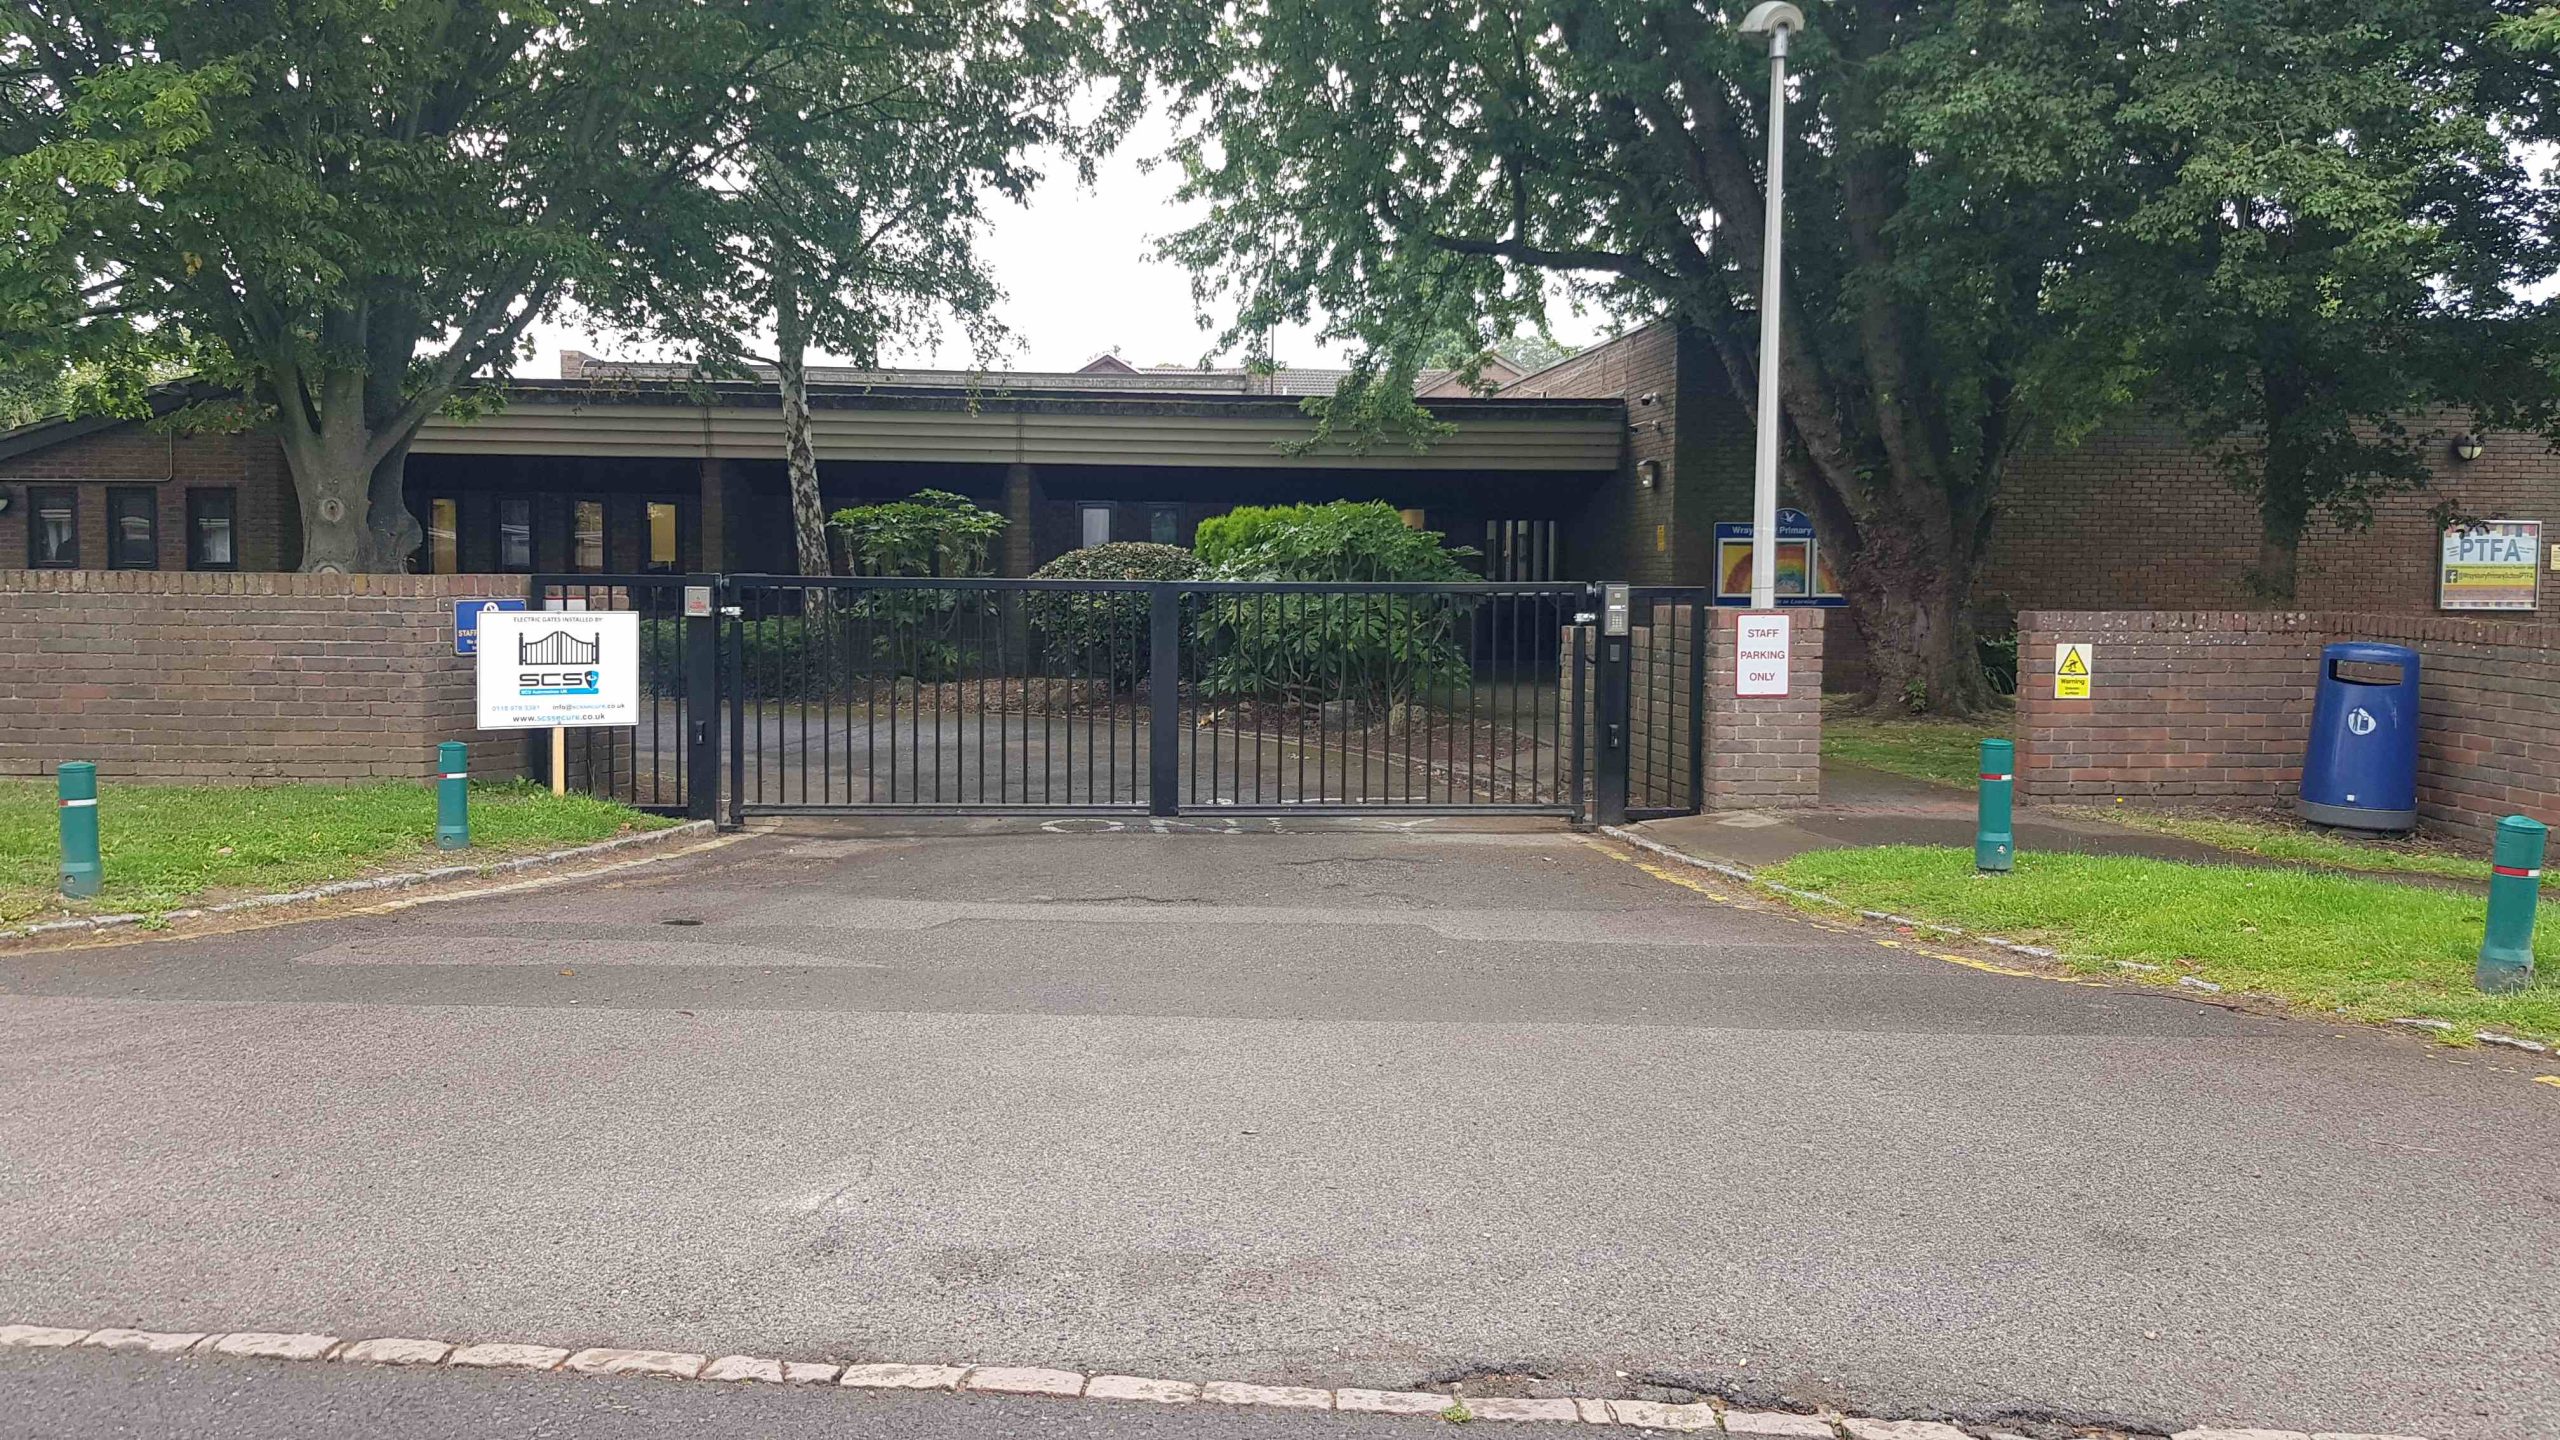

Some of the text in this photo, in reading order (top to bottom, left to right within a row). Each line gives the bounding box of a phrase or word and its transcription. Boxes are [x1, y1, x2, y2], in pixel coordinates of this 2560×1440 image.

[1779, 526, 1812, 536] Primary
[2458, 538, 2522, 562] PTFA
[1747, 628, 1780, 638] STAFF
[1740, 650, 1786, 660] PARKING
[519, 672, 582, 687] SCS
[1749, 672, 1776, 682] ONLY
[512, 712, 606, 722] www.scssecure.co.uk
